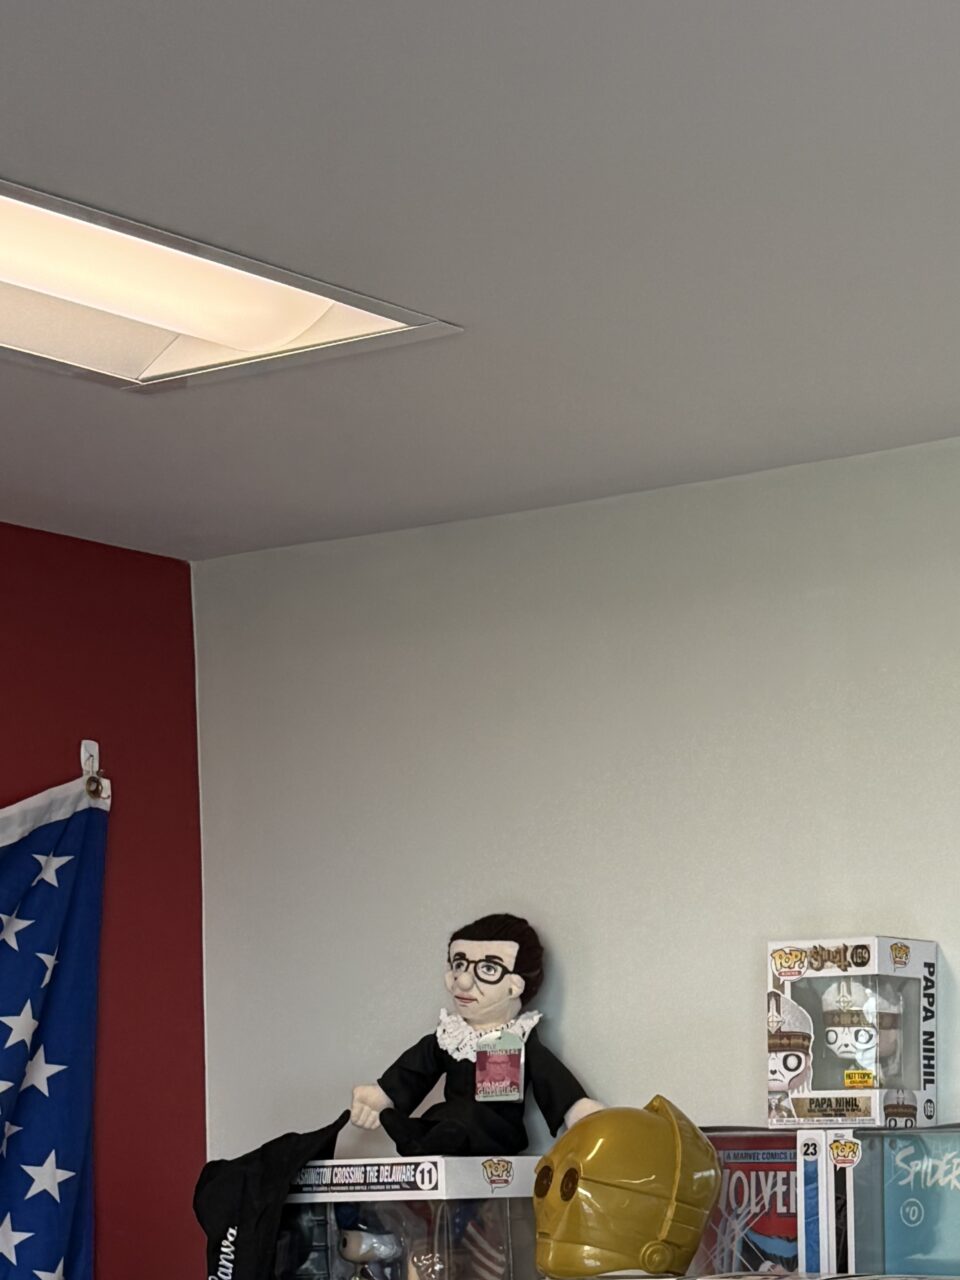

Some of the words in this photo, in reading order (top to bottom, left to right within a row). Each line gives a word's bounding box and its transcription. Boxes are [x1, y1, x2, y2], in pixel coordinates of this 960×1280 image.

[771, 949, 806, 970] POP!
[922, 962, 935, 1022] PAPA
[922, 1031, 935, 1091] NIHIL
[809, 1098, 834, 1109] PAPA
[803, 1143, 817, 1156] 23
[830, 1141, 858, 1159] POP!
[297, 1167, 331, 1184] ASHINGTON
[333, 1166, 365, 1184] CROSSING
[366, 1166, 378, 1183] THE
[379, 1164, 415, 1183] DELAWARE
[418, 1167, 433, 1186] 11
[481, 1158, 513, 1180] POP!
